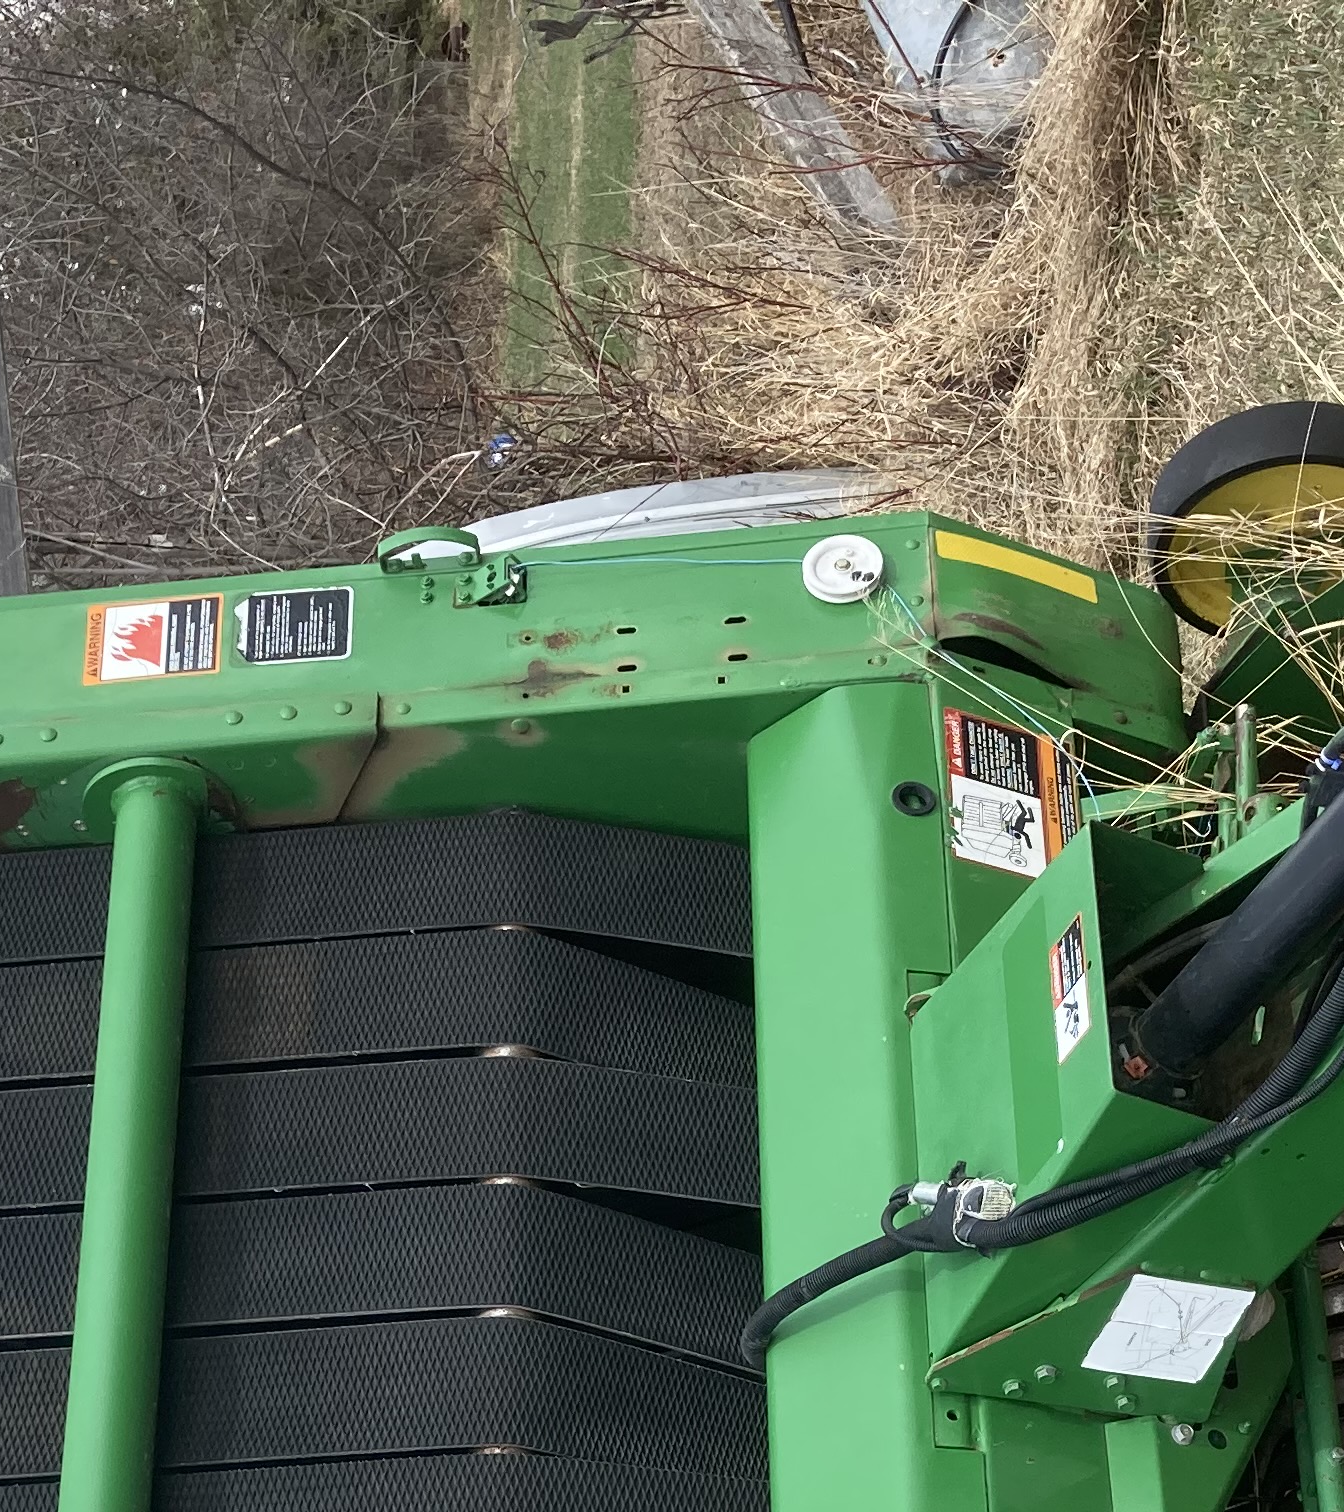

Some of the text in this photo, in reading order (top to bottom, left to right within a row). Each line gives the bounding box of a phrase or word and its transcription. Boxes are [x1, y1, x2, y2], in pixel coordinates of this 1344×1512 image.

[87, 613, 101, 668] WARNING
[950, 720, 961, 756] DANGER
[1047, 777, 1057, 816] WARNING
